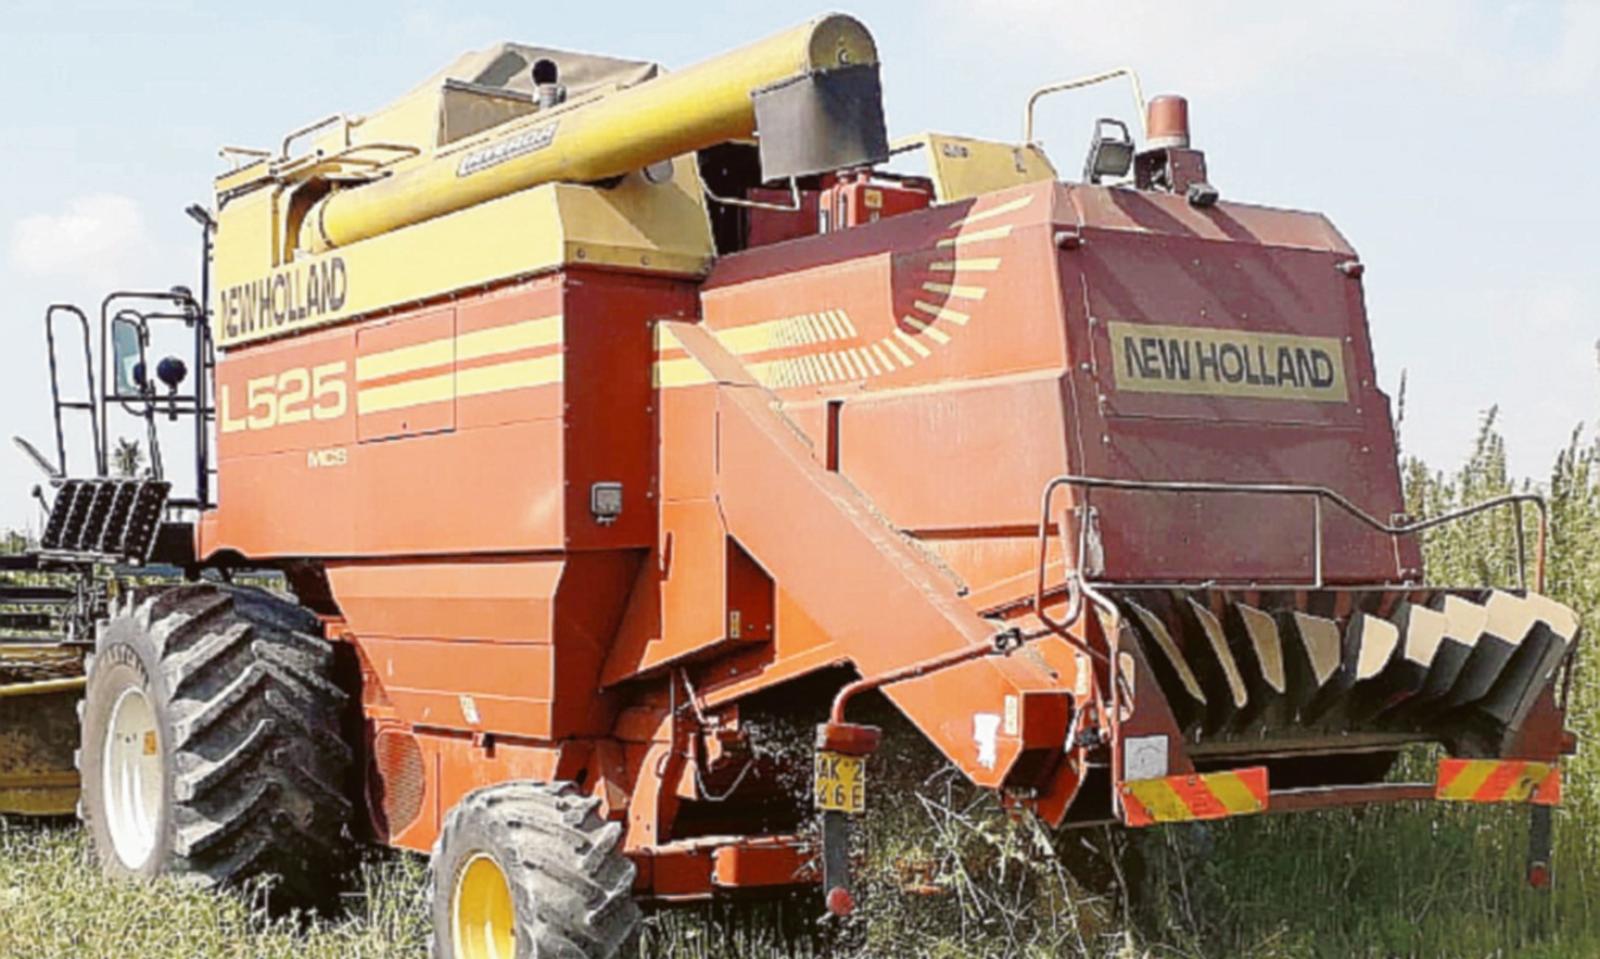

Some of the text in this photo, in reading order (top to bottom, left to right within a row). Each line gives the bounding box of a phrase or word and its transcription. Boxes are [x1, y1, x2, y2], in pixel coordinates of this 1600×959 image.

[221, 257, 347, 339] NEW HOLLAND
[1124, 336, 1335, 388] NEW HOLLAND
[221, 360, 347, 433] L525
[307, 448, 347, 469] MCS
